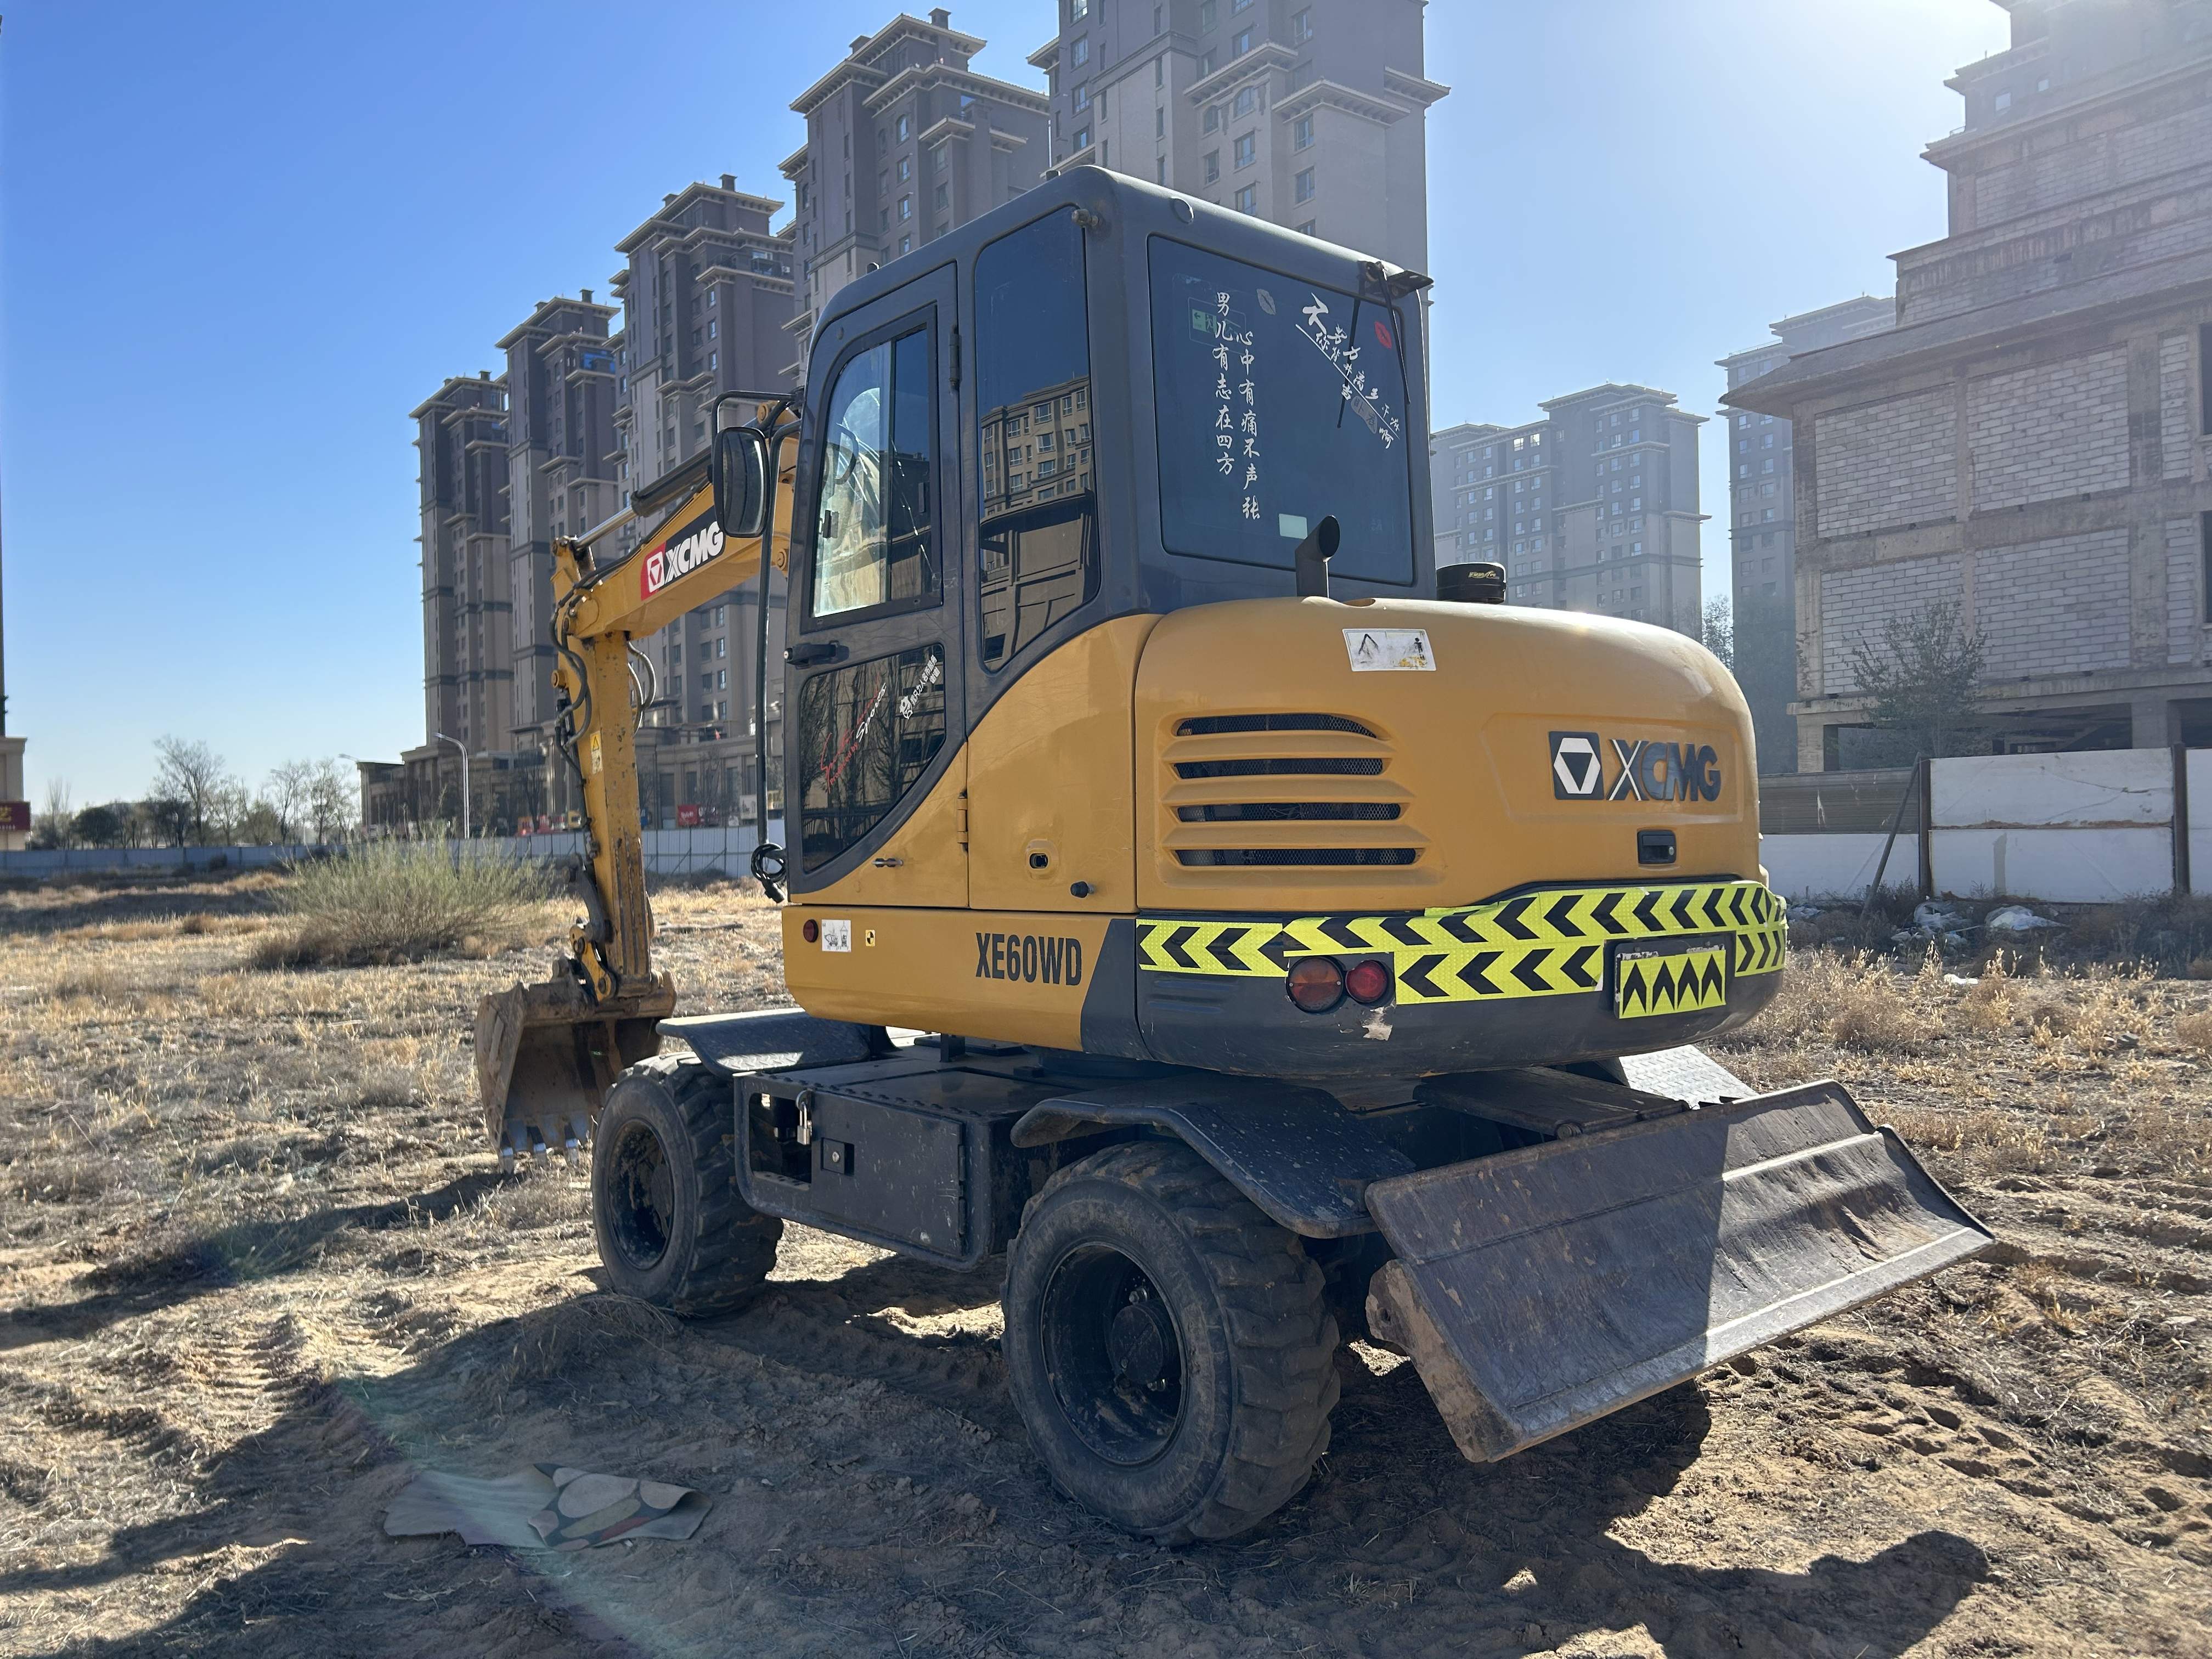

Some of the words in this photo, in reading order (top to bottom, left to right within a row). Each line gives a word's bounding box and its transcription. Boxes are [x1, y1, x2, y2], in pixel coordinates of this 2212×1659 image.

[1302, 292, 1361, 360] 不努力
[1212, 291, 1234, 475] 男儿有志在四方
[1236, 331, 1260, 520] 心中有痛不声张
[665, 521, 723, 584] XCMG
[1606, 738, 1721, 802] XCMG
[975, 932, 1082, 986] XE60WD
